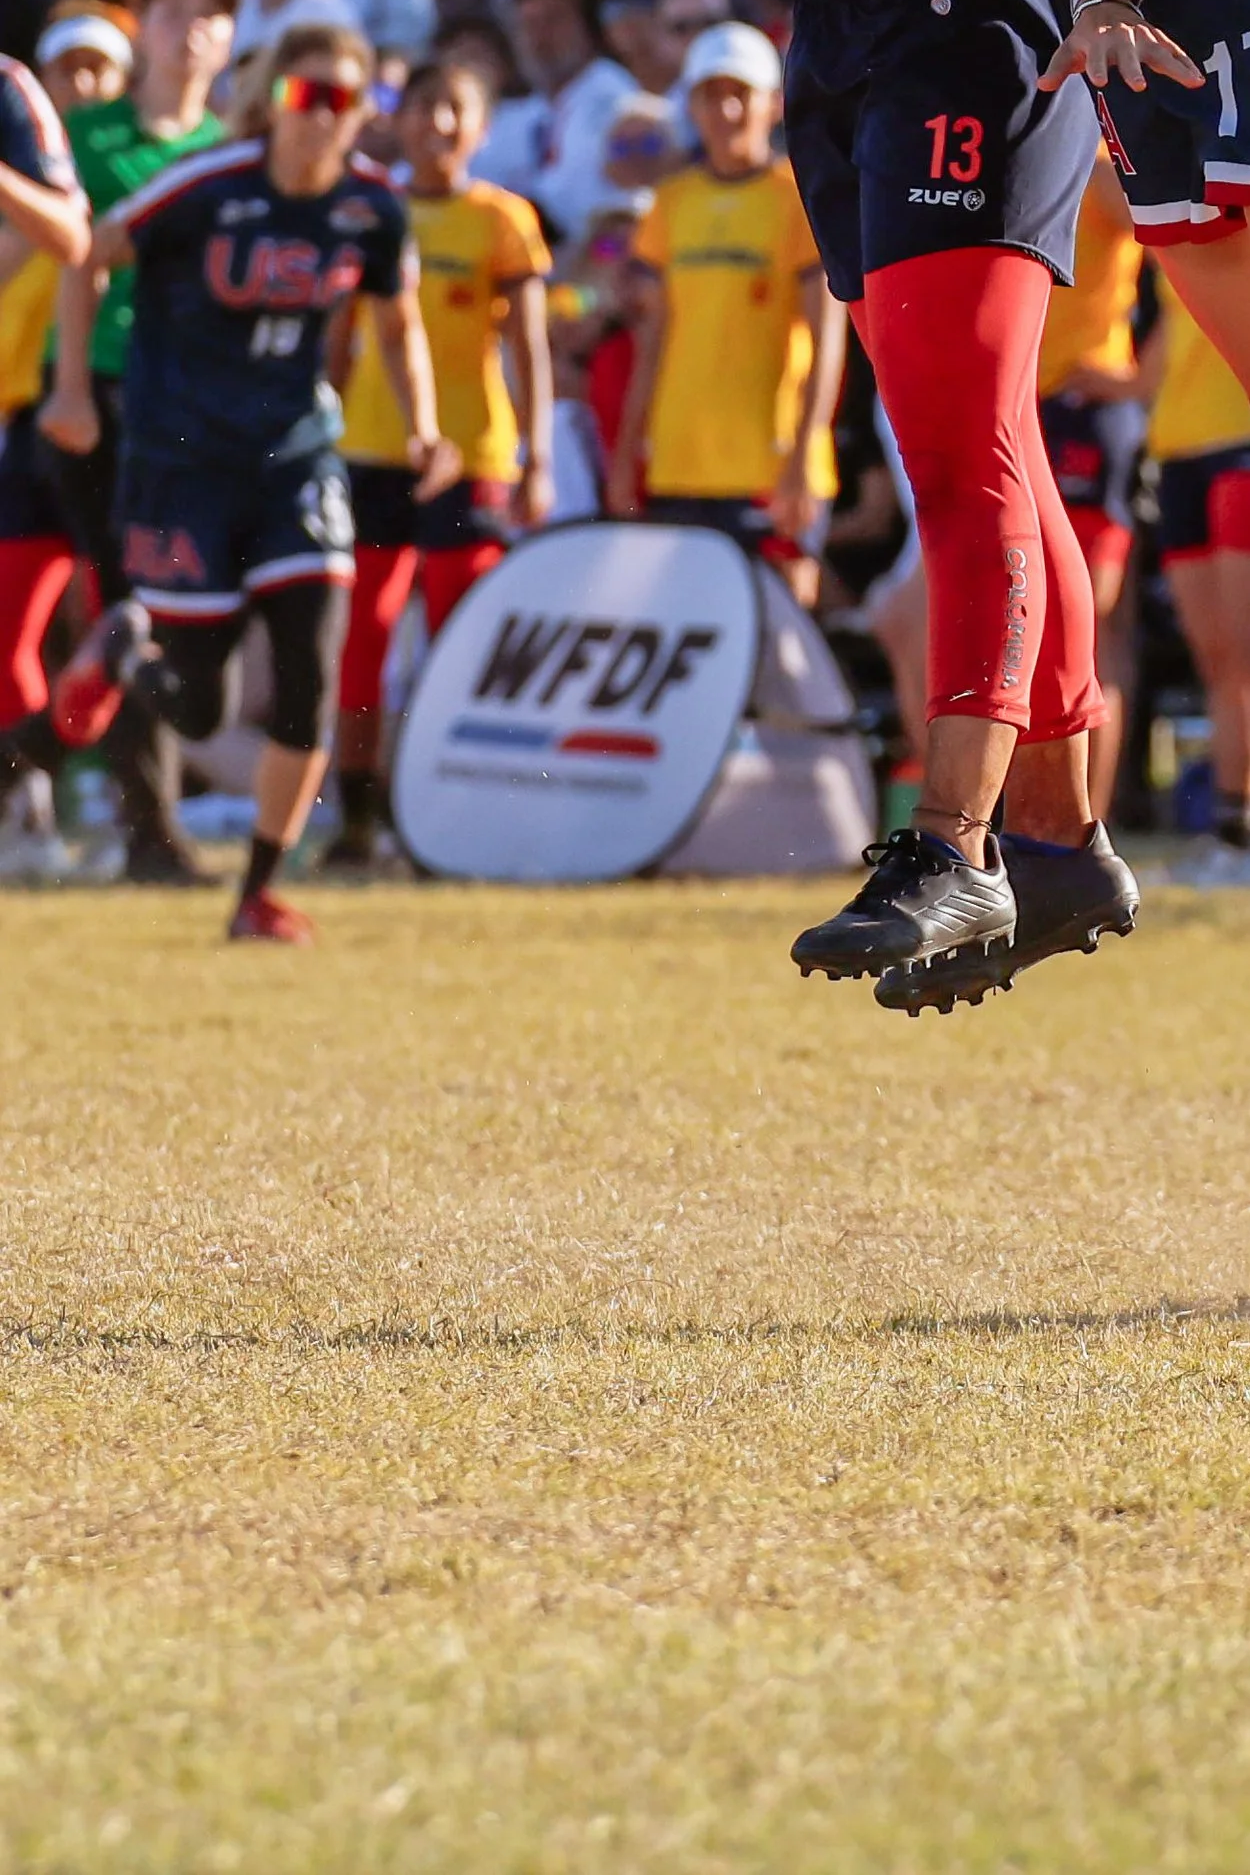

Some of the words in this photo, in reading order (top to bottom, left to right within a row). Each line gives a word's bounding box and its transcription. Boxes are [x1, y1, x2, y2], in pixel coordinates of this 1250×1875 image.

[924, 113, 985, 183] 13
[206, 235, 364, 310] USA
[473, 612, 720, 718] WFDF
